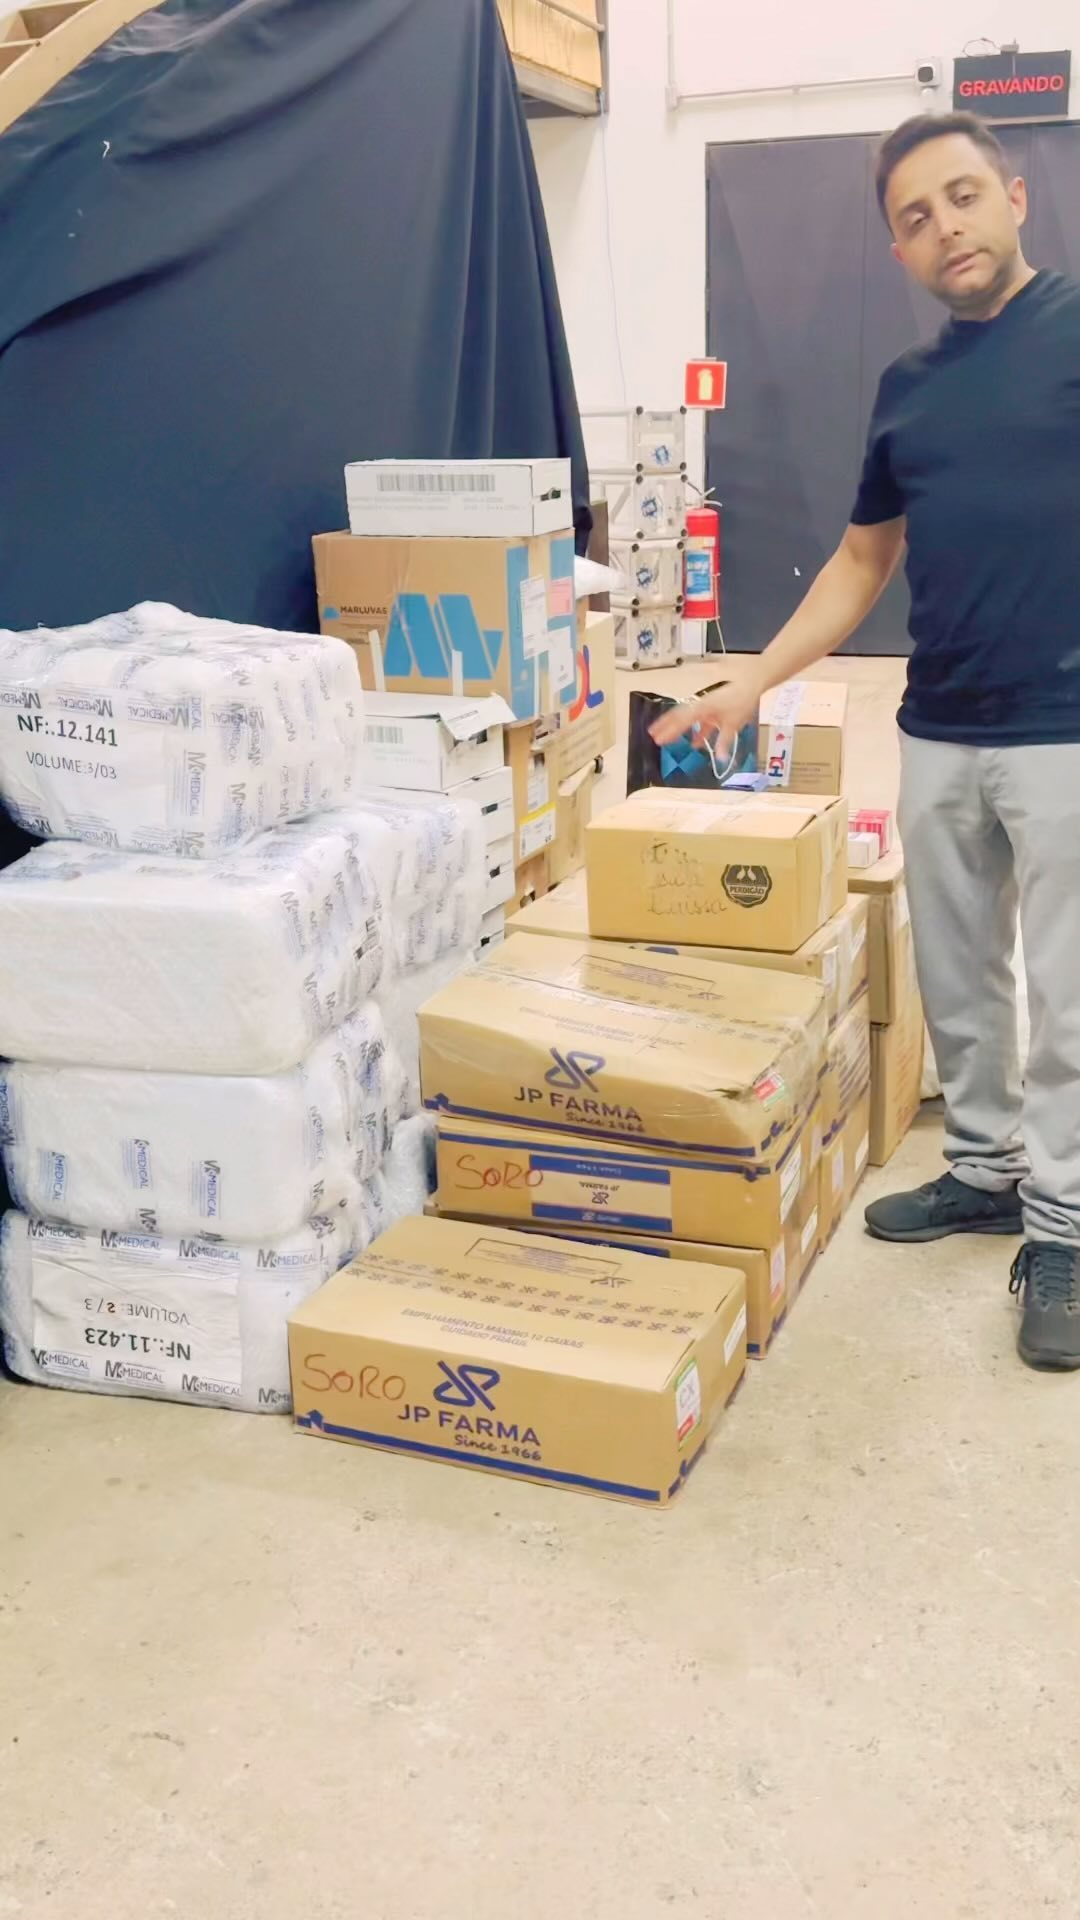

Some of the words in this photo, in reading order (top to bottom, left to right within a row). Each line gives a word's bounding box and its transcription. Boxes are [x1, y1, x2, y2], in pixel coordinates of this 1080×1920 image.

[959, 75, 1064, 97] GRAVANDO
[340, 606, 387, 615] MARLUVAS
[514, 1087, 543, 1103] JP
[549, 1092, 643, 1122] FARMA
[565, 1111, 604, 1127] Since
[118, 1236, 161, 1250] MEDICAL
[197, 1245, 240, 1262] MEDICAL
[277, 1254, 318, 1266] MEDICAL
[48, 1354, 90, 1370] MEDICAL
[122, 1367, 164, 1384] MEDICAL
[199, 1381, 242, 1397] MEDICAL
[397, 1404, 431, 1423] JP
[438, 1410, 542, 1447] FARMA
[455, 1434, 497, 1452] Since
[501, 1444, 542, 1461] 1966
